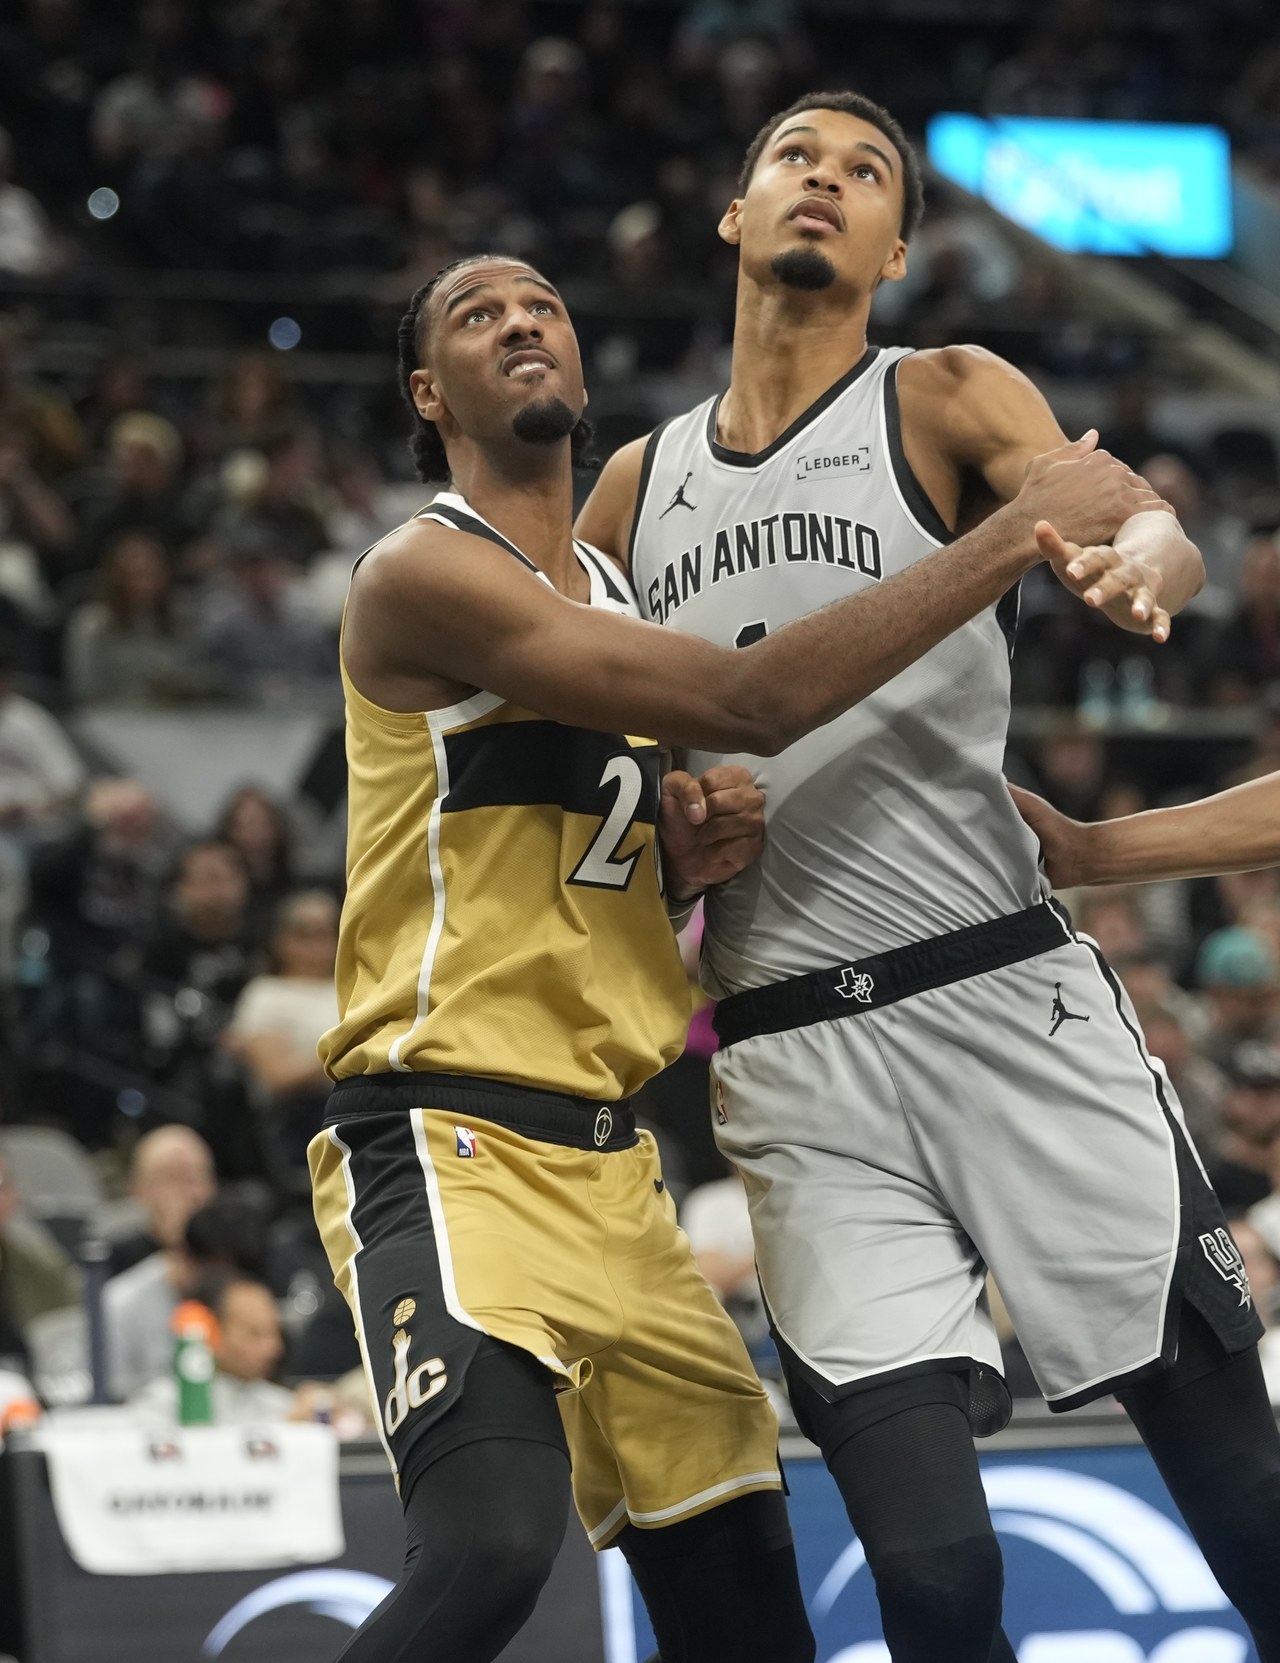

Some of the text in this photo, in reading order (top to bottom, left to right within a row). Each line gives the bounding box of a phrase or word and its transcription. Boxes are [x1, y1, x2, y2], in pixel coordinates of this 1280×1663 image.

[805, 454, 860, 471] LEDGER
[648, 511, 883, 626] SAN ANTONIO
[565, 751, 664, 898] 2
